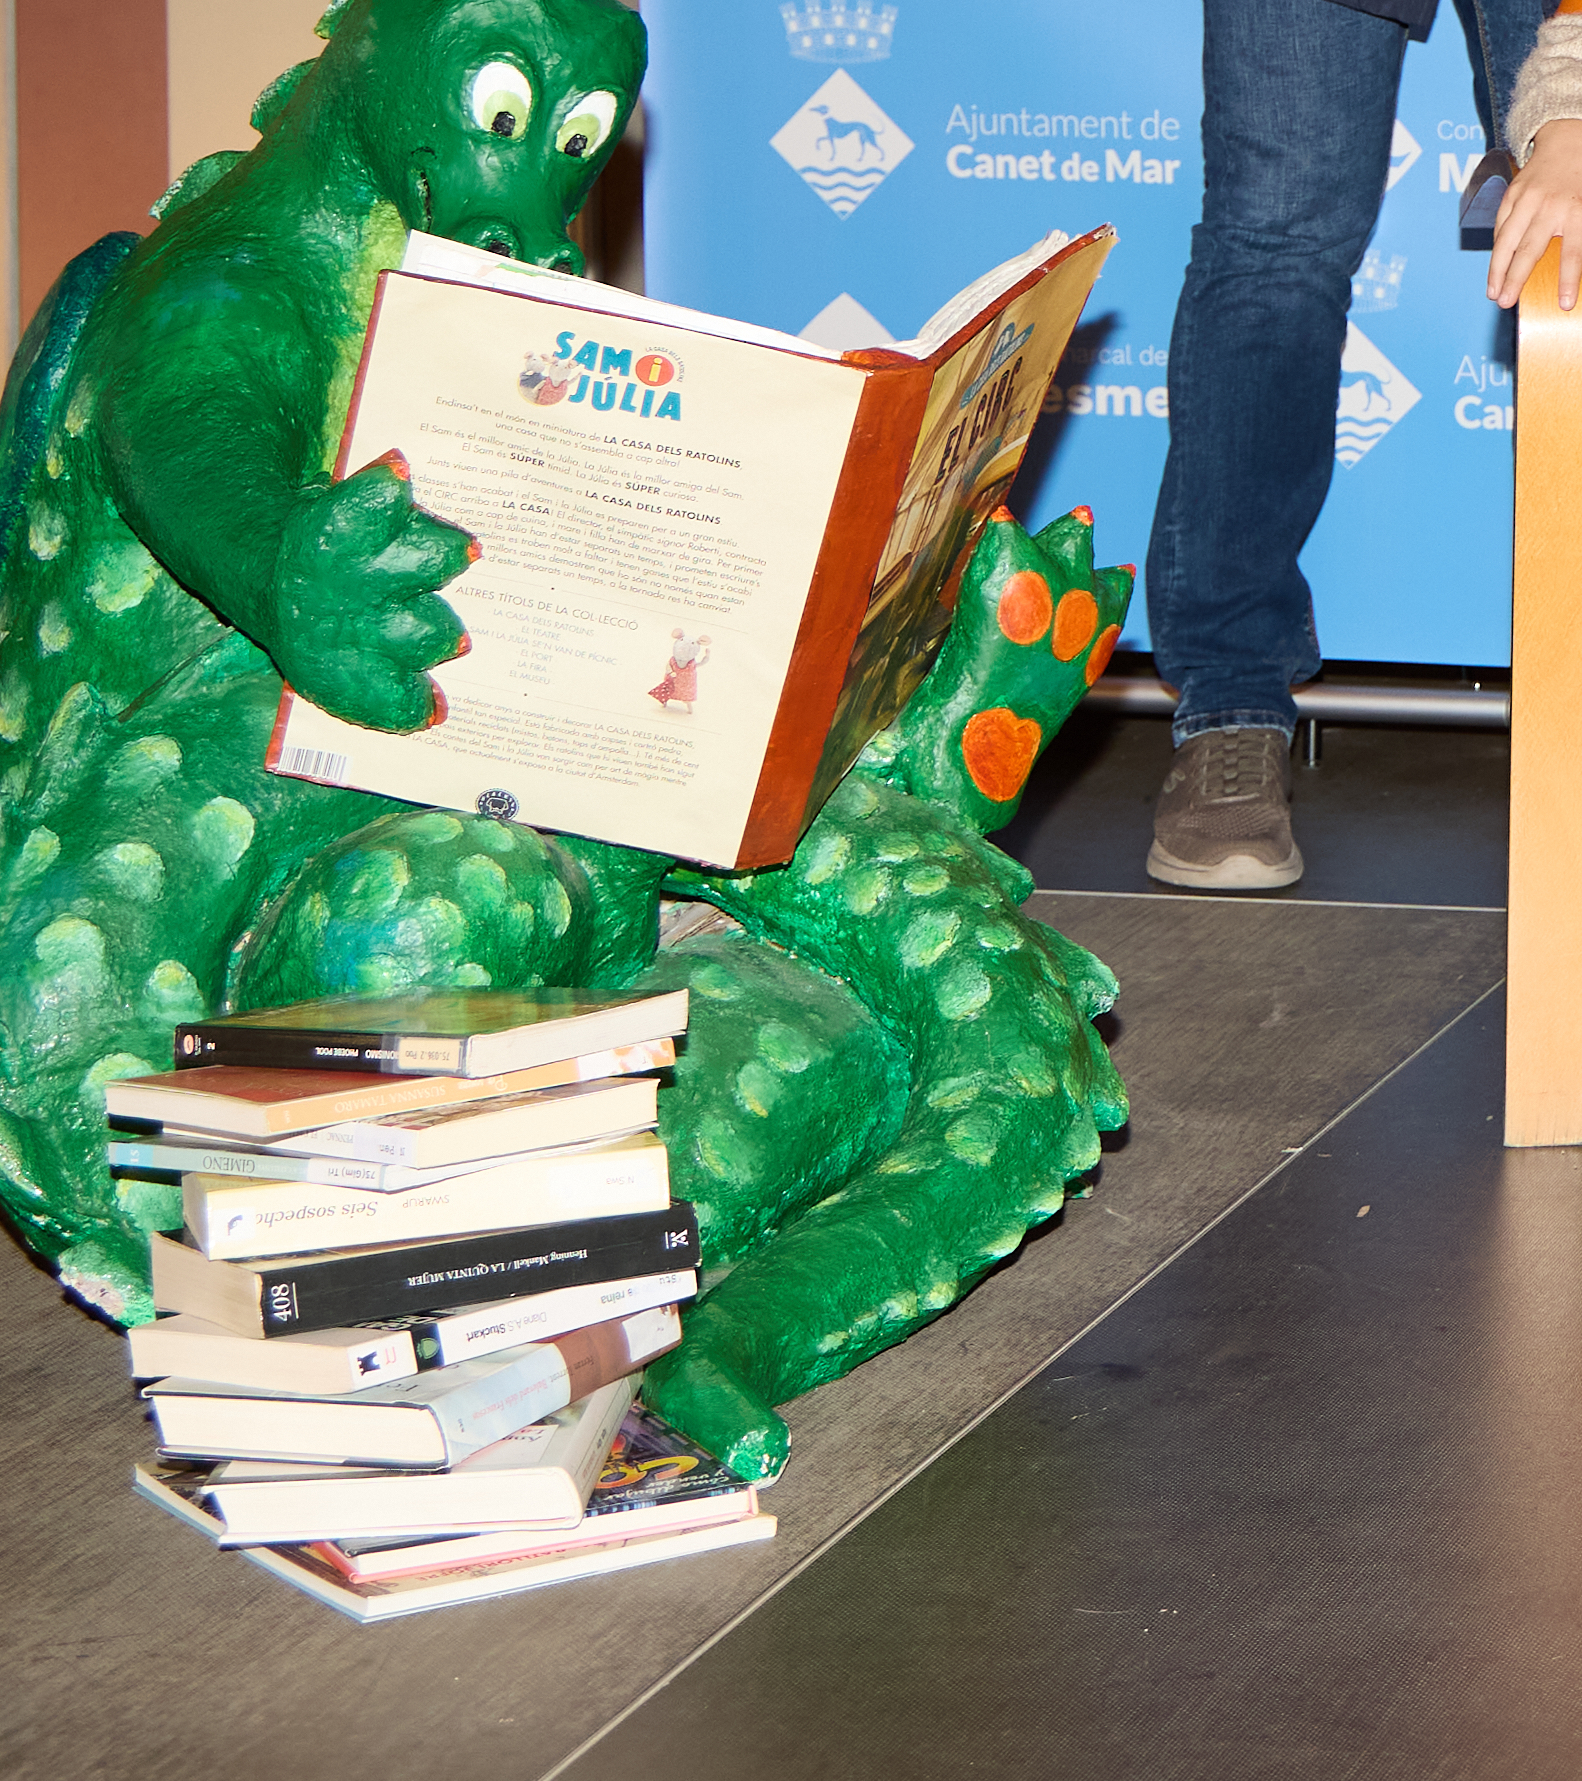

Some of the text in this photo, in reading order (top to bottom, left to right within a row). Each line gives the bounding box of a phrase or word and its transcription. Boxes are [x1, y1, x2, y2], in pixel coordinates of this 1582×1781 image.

[946, 103, 1180, 143] Ajuntament de
[945, 143, 1180, 185] Canet de Mar
[551, 330, 634, 377] SAM
[568, 376, 682, 422] JÚLIA
[603, 434, 618, 444] LA
[620, 437, 653, 451] CASA
[655, 443, 682, 457] DELS
[508, 451, 546, 468] SÚPER
[624, 478, 661, 496] SÚPER
[584, 489, 599, 500] LA
[601, 493, 633, 508] CASA
[635, 501, 663, 514] DELS
[454, 584, 495, 601] ALTRES
[497, 590, 535, 608] TÍTOLS
[536, 600, 553, 612] DE
[554, 604, 569, 616] LA
[333, 1085, 445, 1113] SUSANNA TAMARO
[202, 1155, 255, 1173] GIMENO
[341, 1200, 378, 1217] Seis
[401, 1193, 449, 1208] SWARUP
[512, 1255, 548, 1268] Mankell
[549, 1248, 587, 1261] Henning
[406, 1270, 444, 1286] MUJER
[445, 1263, 489, 1280] QUINTA
[490, 1261, 504, 1272] LA
[270, 1283, 292, 1321] 408
[465, 1322, 505, 1343] Stuckart
